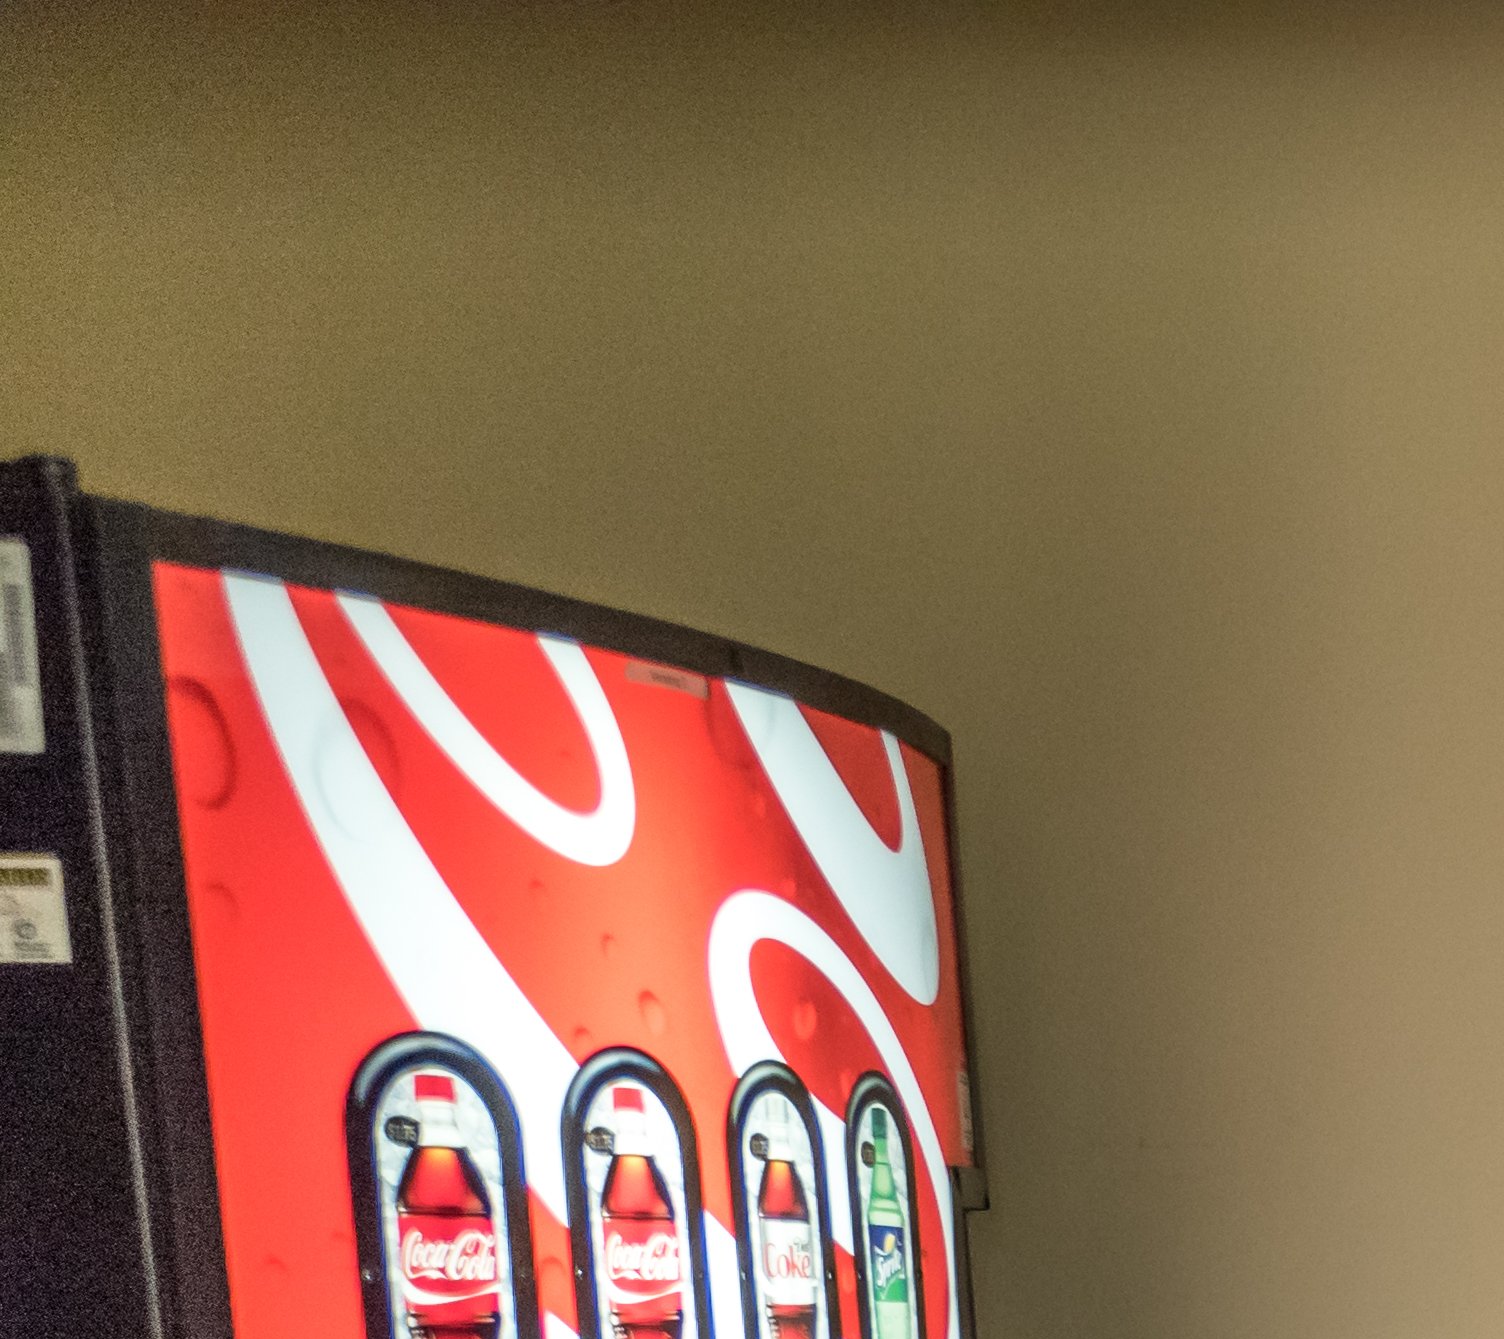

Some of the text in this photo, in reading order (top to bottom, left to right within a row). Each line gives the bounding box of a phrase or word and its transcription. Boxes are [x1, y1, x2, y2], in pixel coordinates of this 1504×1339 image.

[405, 1231, 496, 1281] Coca-Cola
[604, 1232, 679, 1281] Coca-Cola
[763, 1242, 810, 1280] Coke
